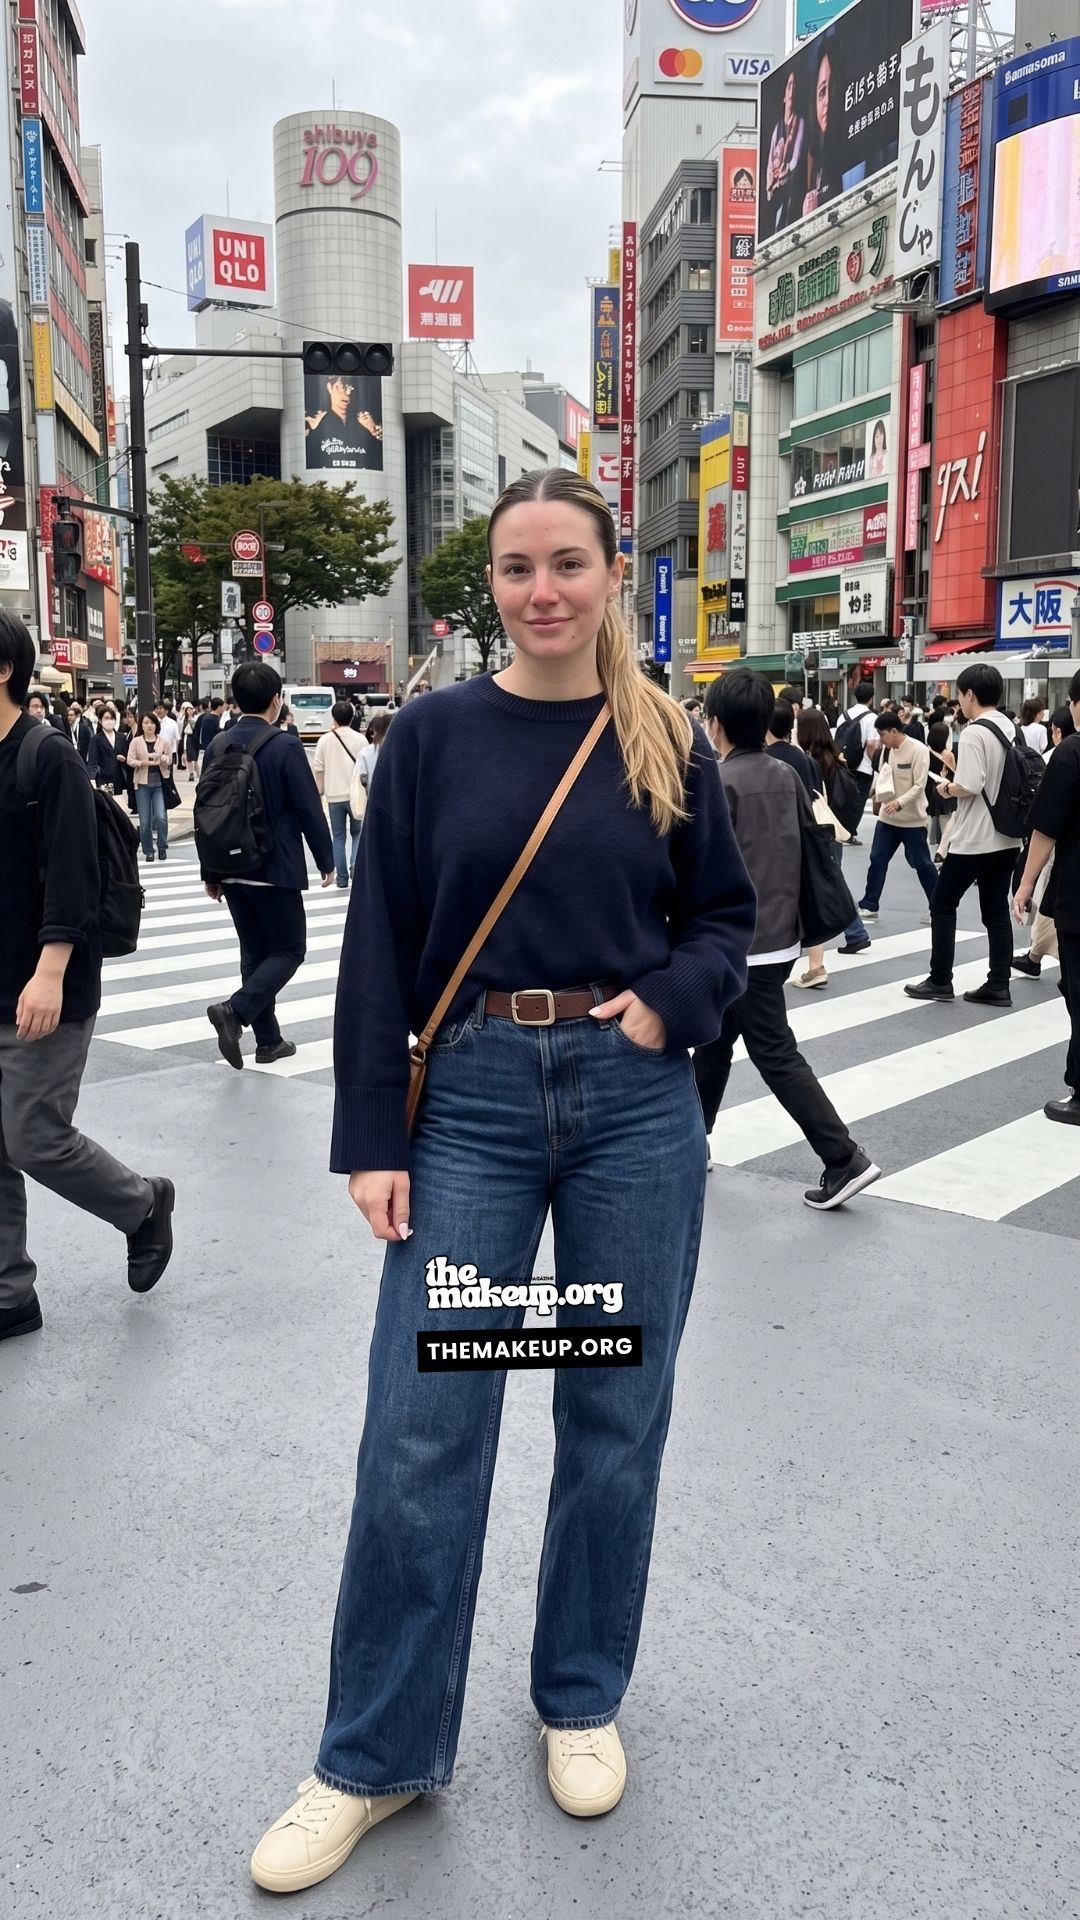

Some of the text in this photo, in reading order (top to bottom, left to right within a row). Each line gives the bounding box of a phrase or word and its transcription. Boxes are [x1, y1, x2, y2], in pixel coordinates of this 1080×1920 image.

[728, 58, 771, 76] VISA
[304, 124, 378, 150] shibuya
[899, 45, 940, 256] もんじゃ
[297, 146, 378, 201] 109
[188, 234, 201, 263] UNI
[219, 237, 256, 260] UNI
[189, 261, 203, 291] QLO
[220, 260, 260, 284] QLO
[1008, 589, 1062, 626] 大阪
